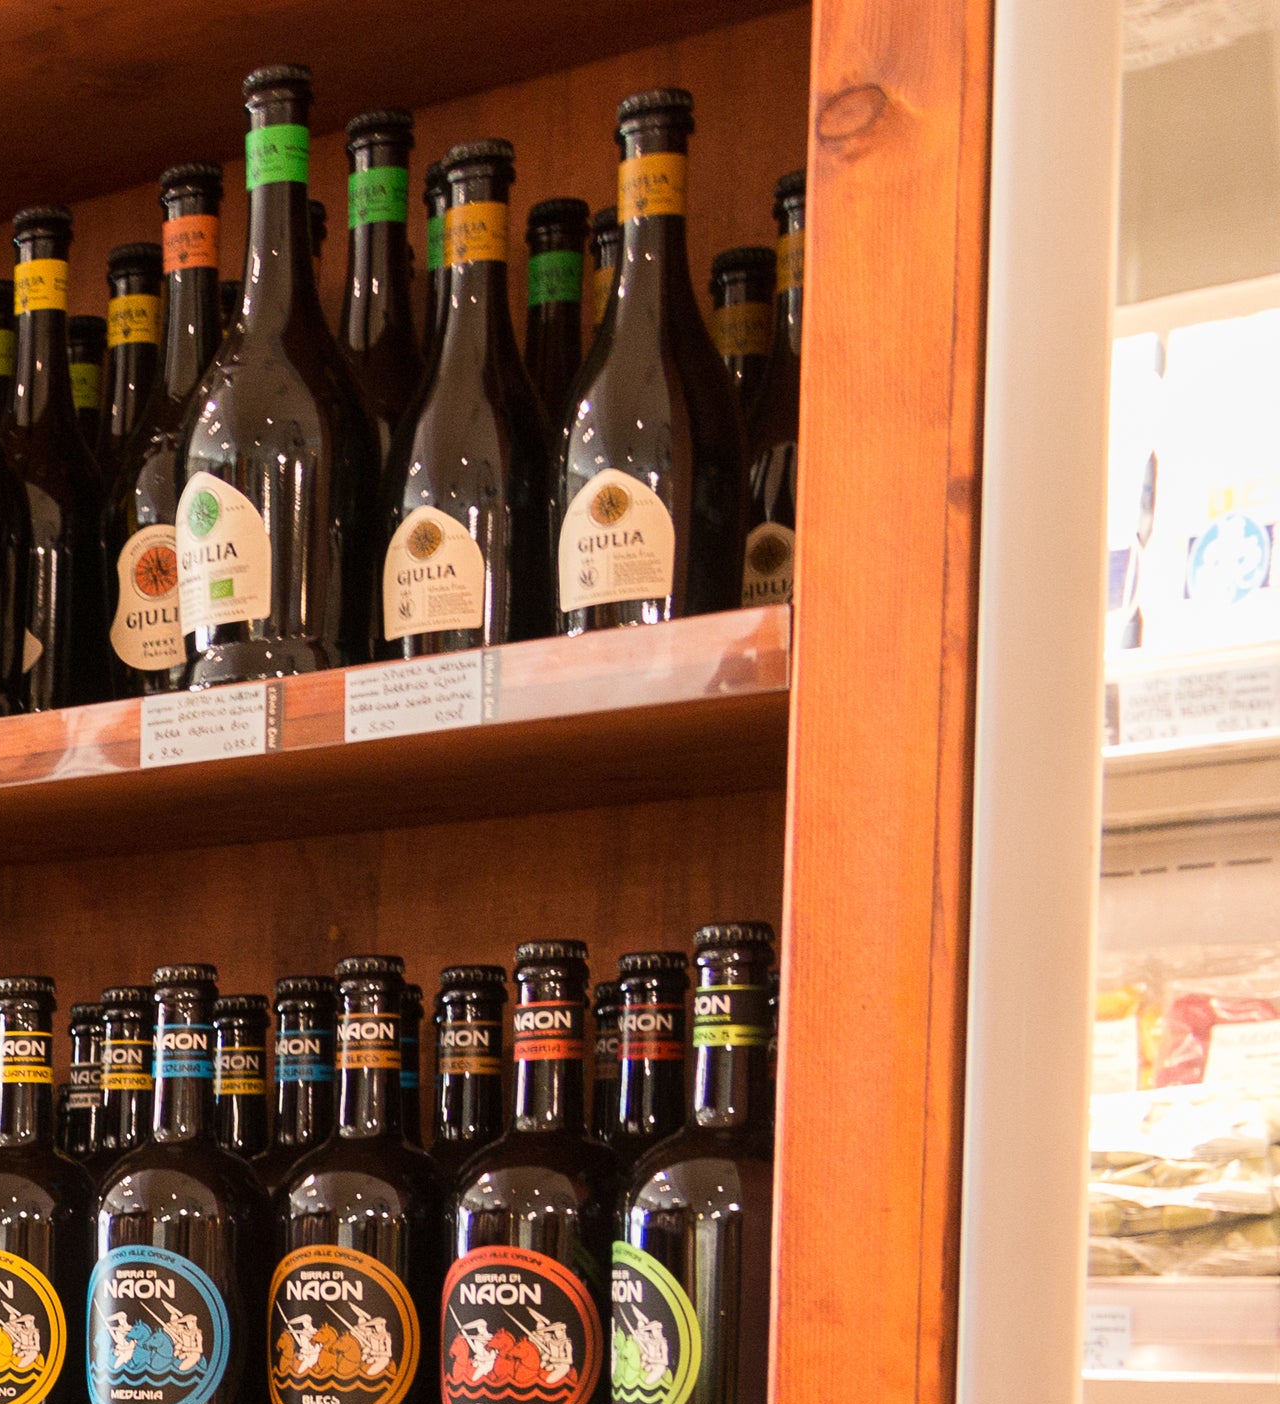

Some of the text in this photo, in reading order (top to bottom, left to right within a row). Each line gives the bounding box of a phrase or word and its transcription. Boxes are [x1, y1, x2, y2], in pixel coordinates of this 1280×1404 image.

[578, 531, 644, 552] GJULIA
[398, 565, 455, 584] GJULIA
[127, 607, 178, 630] GJULI
[514, 1011, 571, 1031] NAON
[618, 1014, 672, 1031] NAON
[338, 1023, 393, 1040] NAON
[153, 1033, 206, 1050] NAON
[116, 1270, 156, 1279] BIRRA DI
[301, 1271, 343, 1280] BIRRA DI
[475, 1274, 520, 1283] BIRRA DI
[104, 1279, 174, 1299] NAON
[287, 1280, 363, 1300] NAON
[460, 1284, 541, 1304] NAON
[111, 1390, 162, 1400] MEDUNIA
